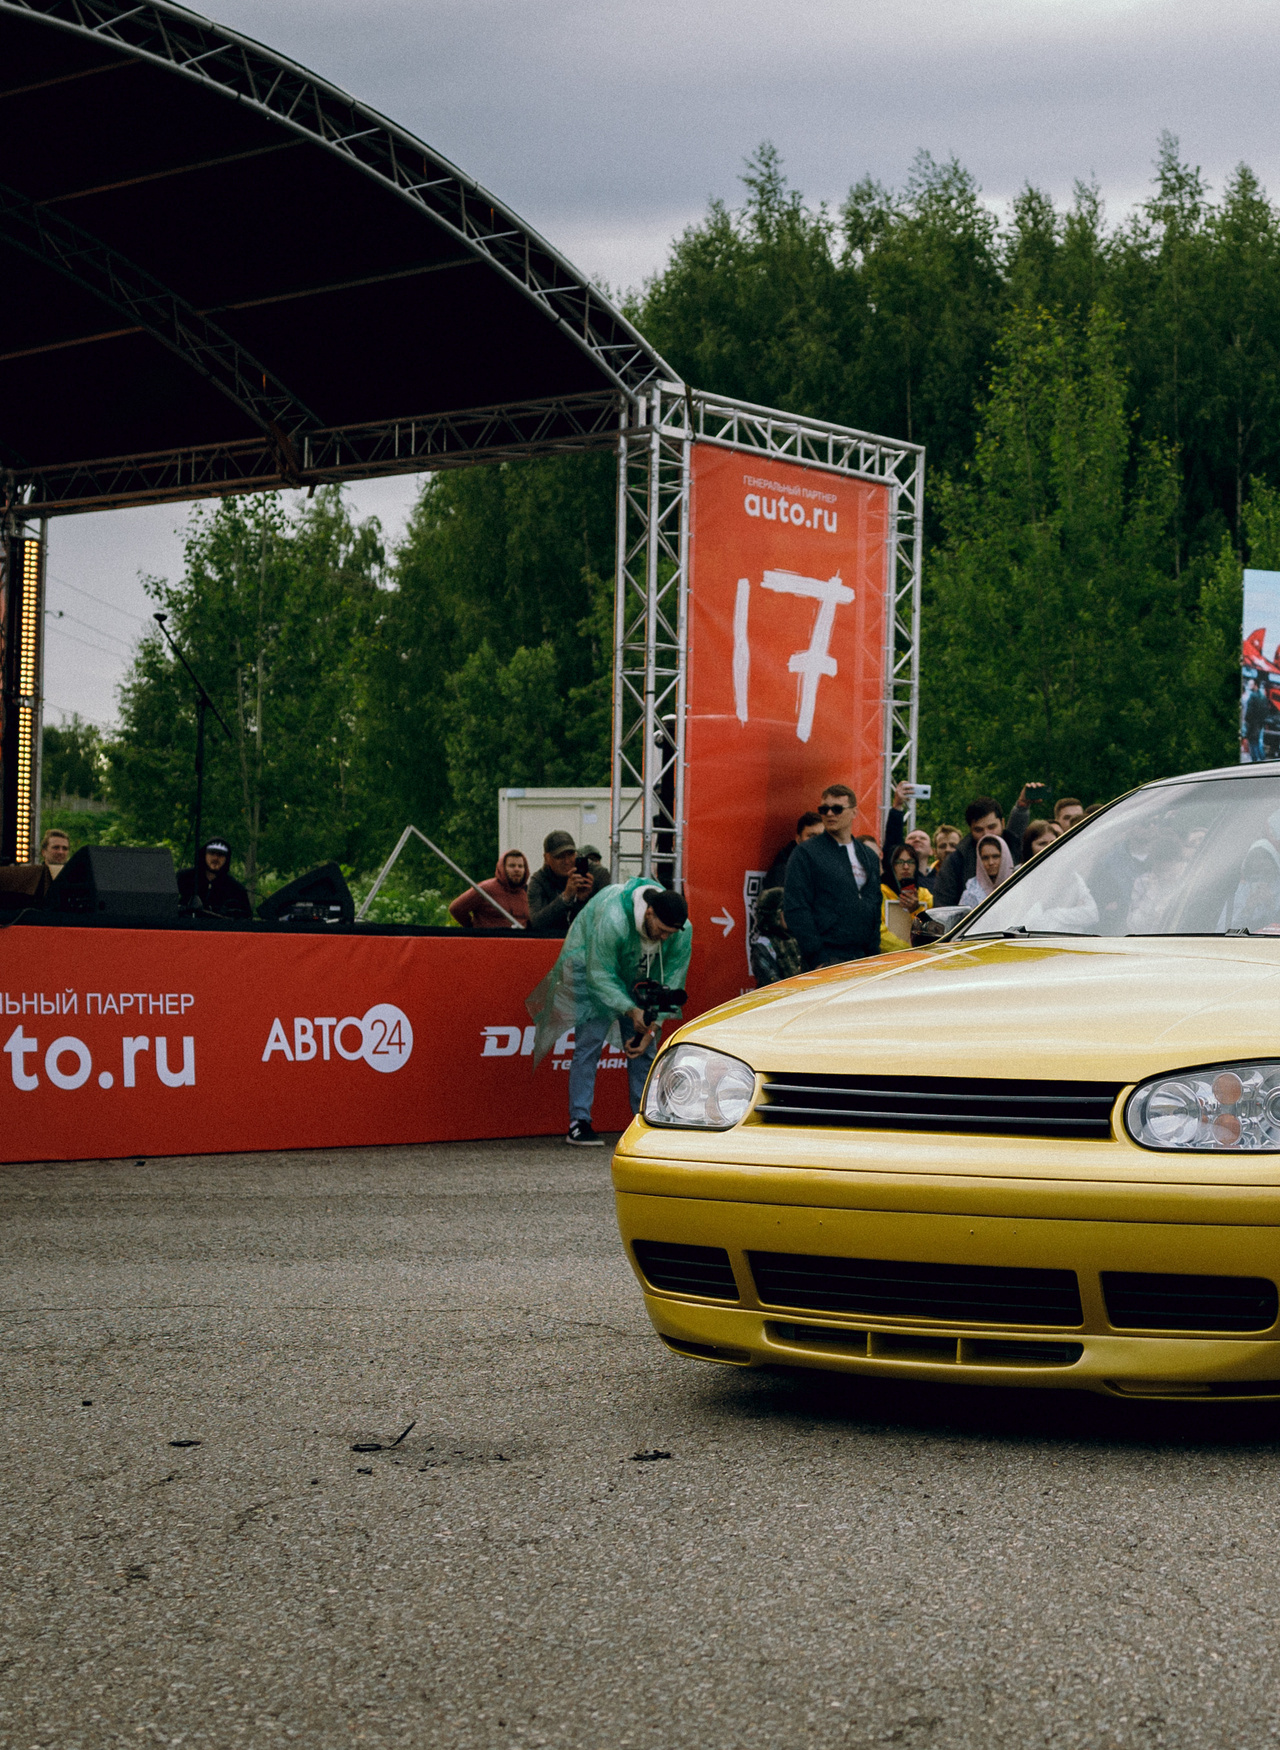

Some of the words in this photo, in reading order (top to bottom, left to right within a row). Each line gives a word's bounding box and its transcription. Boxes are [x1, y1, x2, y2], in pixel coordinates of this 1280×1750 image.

[743, 493, 838, 533] auto.ru
[732, 569, 856, 744] 17
[0, 988, 78, 1015] ЬНЫЙ
[86, 993, 195, 1015] ПАРТНЕР
[3, 1024, 196, 1092] to.ru
[261, 1014, 408, 1063] АВТО24
